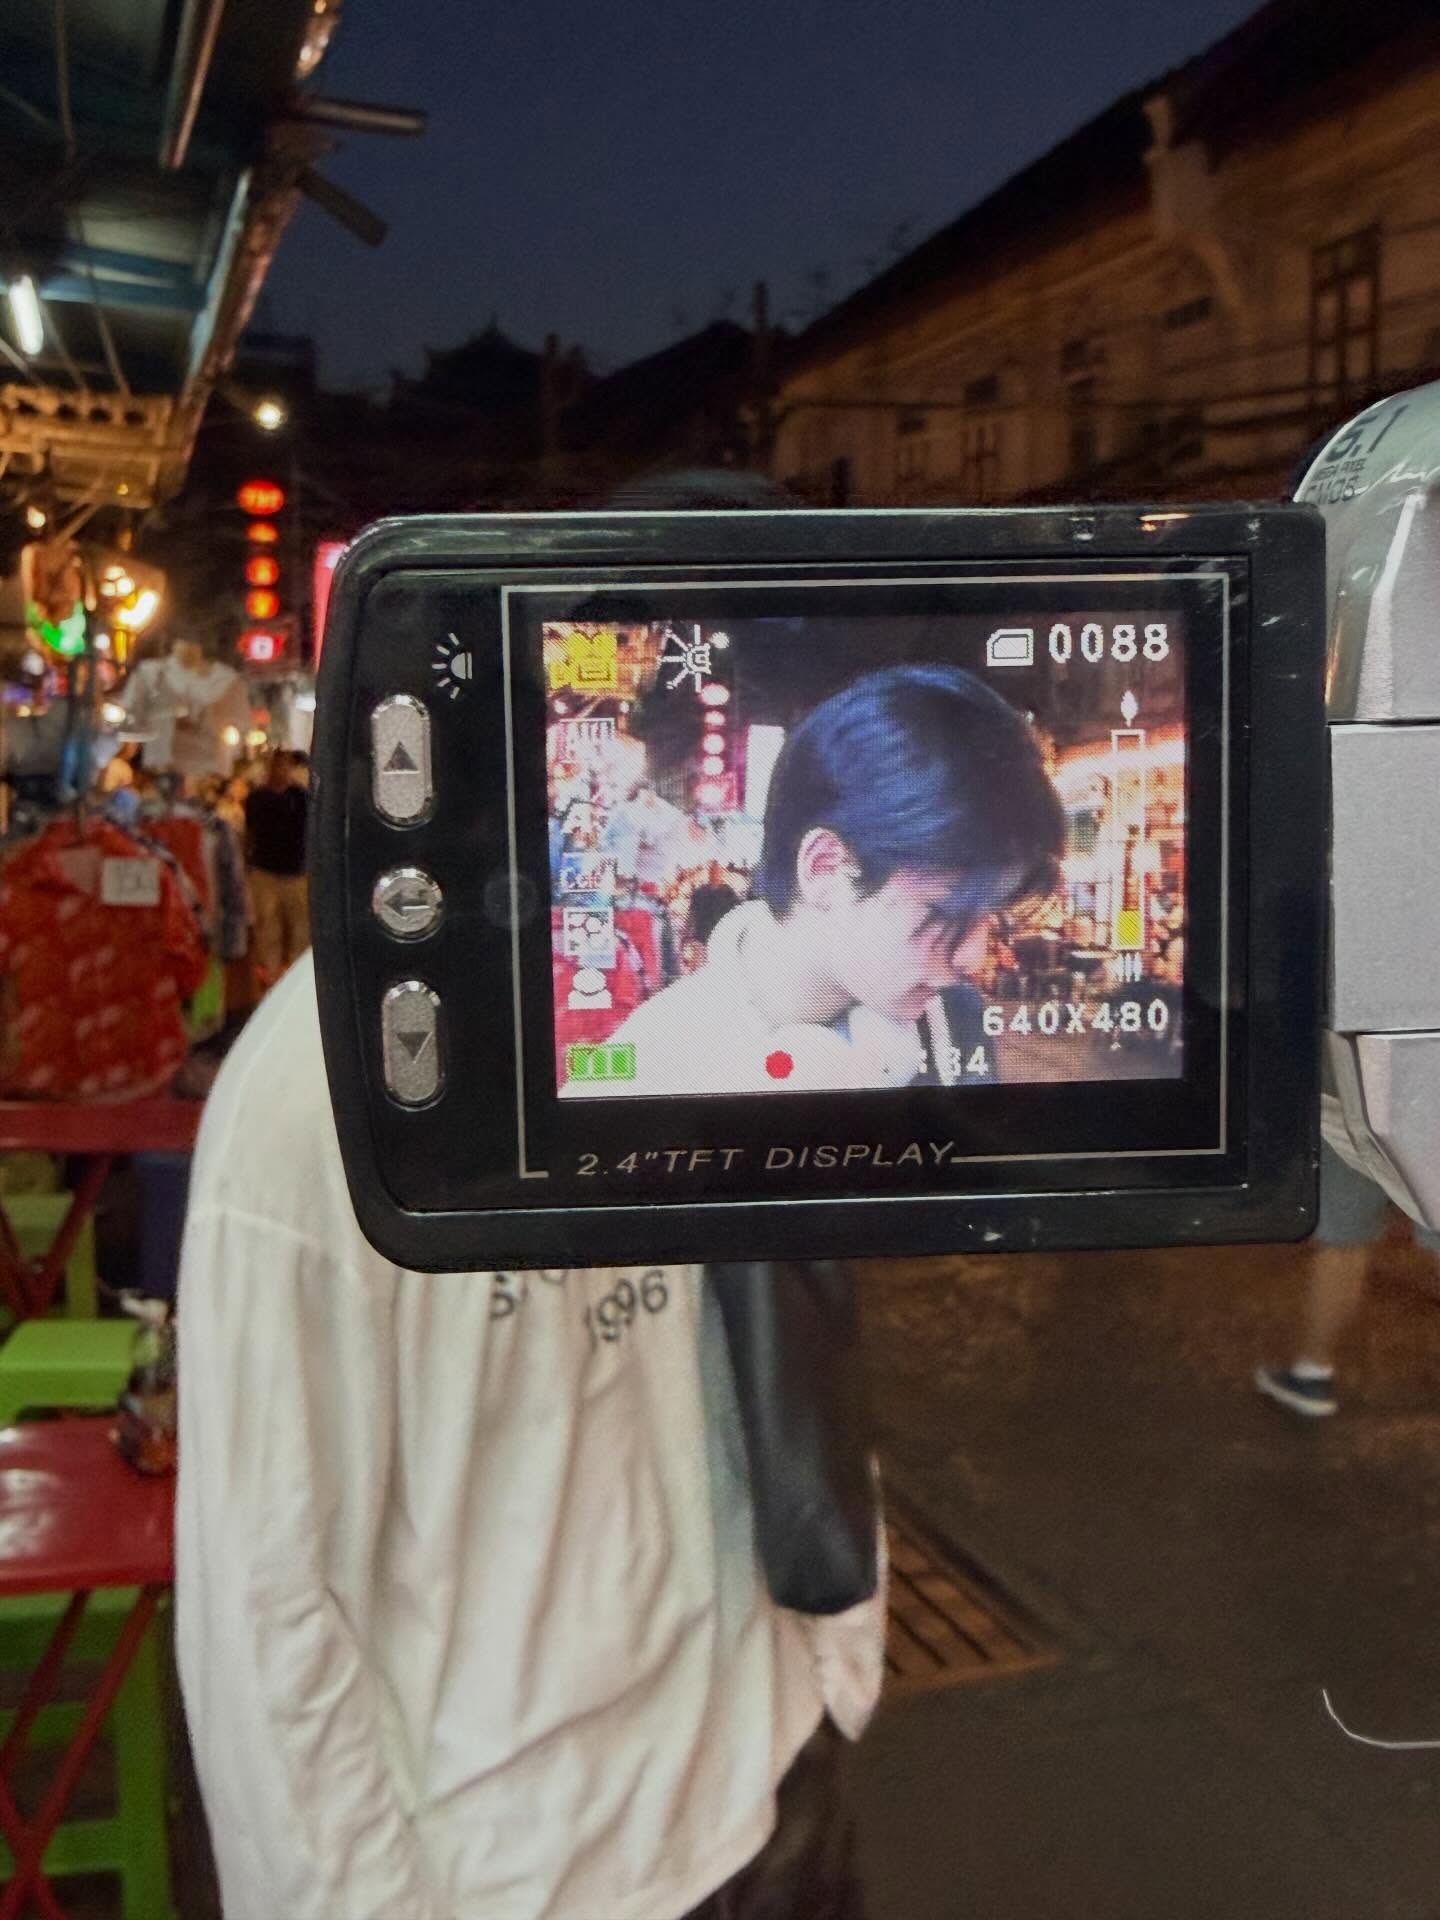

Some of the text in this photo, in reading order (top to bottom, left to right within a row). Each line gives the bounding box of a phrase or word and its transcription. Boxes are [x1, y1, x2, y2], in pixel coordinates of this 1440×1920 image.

[1048, 622, 1170, 663] 0088
[982, 998, 1169, 1036] 640X480
[576, 1140, 955, 1177] 2.4"TFT DISPLAY
